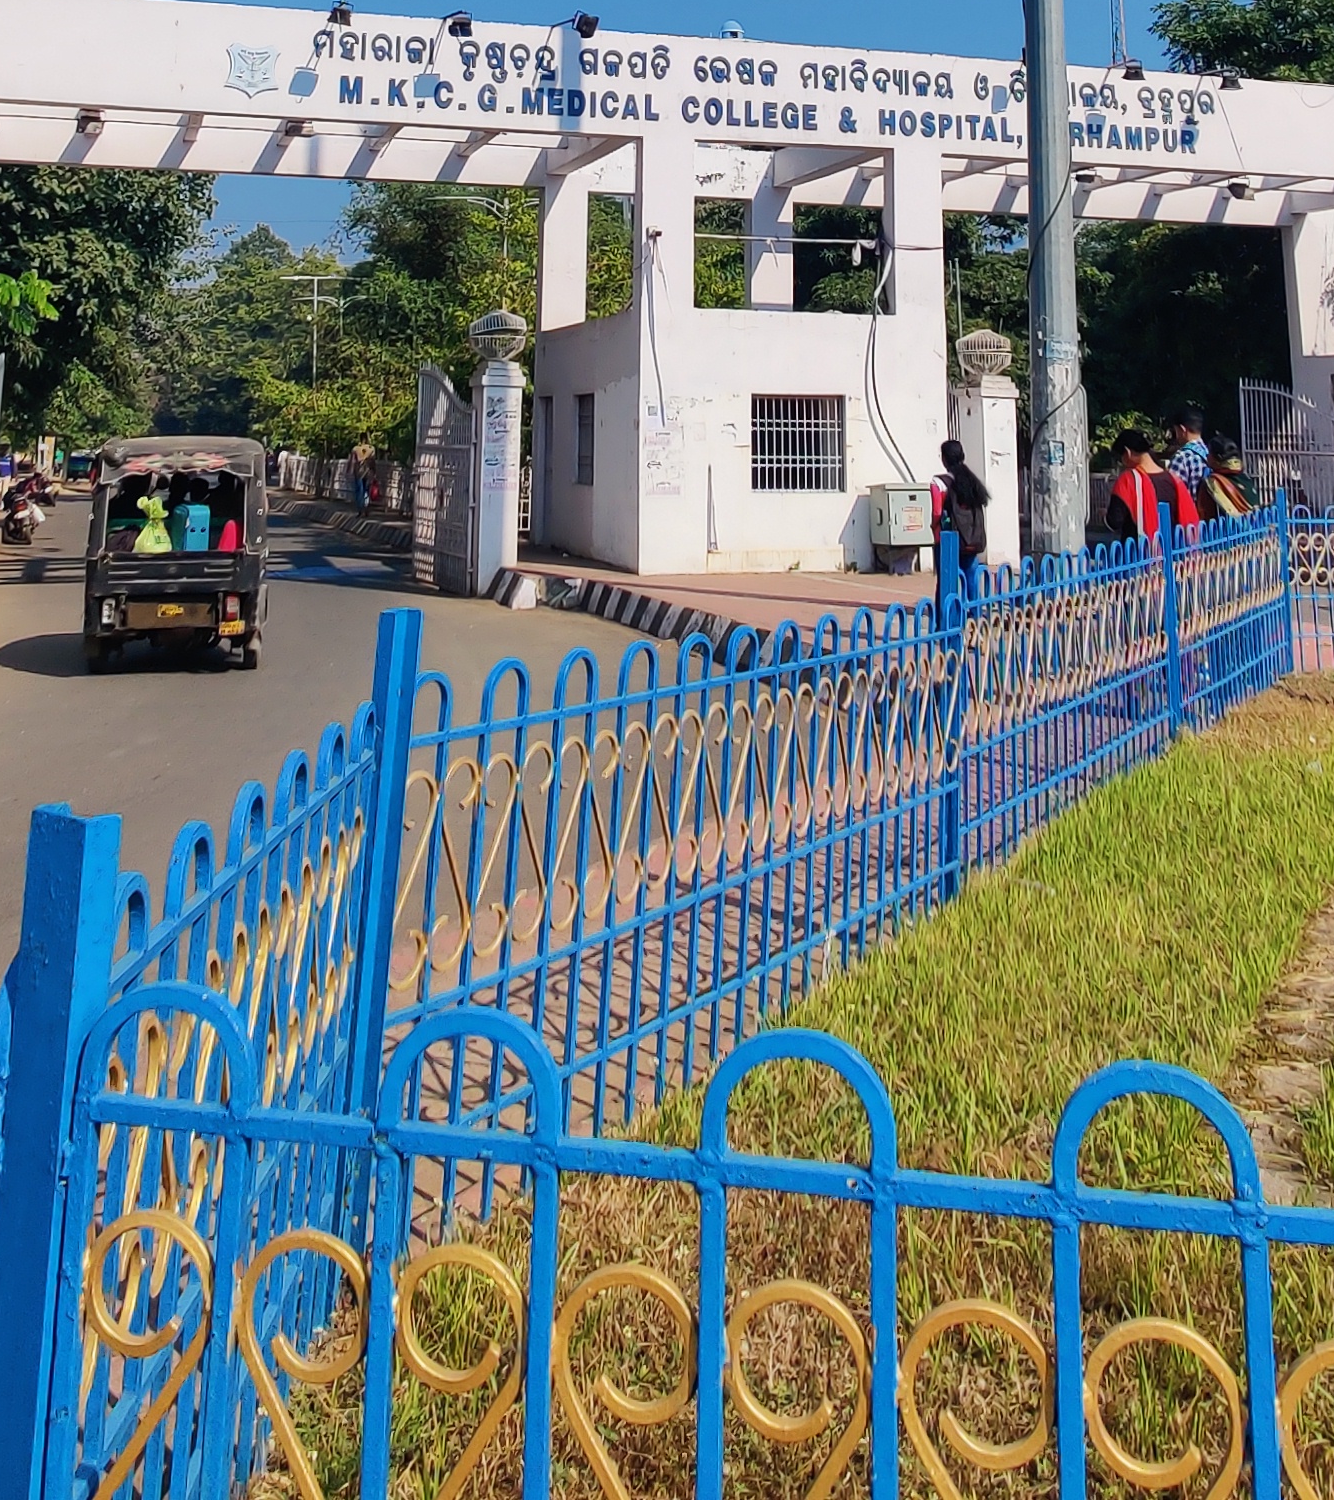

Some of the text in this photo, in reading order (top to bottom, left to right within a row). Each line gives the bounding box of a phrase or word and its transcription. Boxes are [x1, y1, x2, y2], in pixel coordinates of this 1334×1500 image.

[578, 44, 671, 80] ଗଜପତି
[693, 55, 779, 87] ଭେଷଜ
[799, 58, 955, 100] ମହାବିଦ୍ୟାଳୟ
[973, 71, 990, 101] ଓ
[680, 95, 819, 131] COLLEGE
[838, 105, 858, 134] &
[877, 108, 1023, 150] HOSPITAL,
[1068, 122, 1197, 155] RHAMPUR
